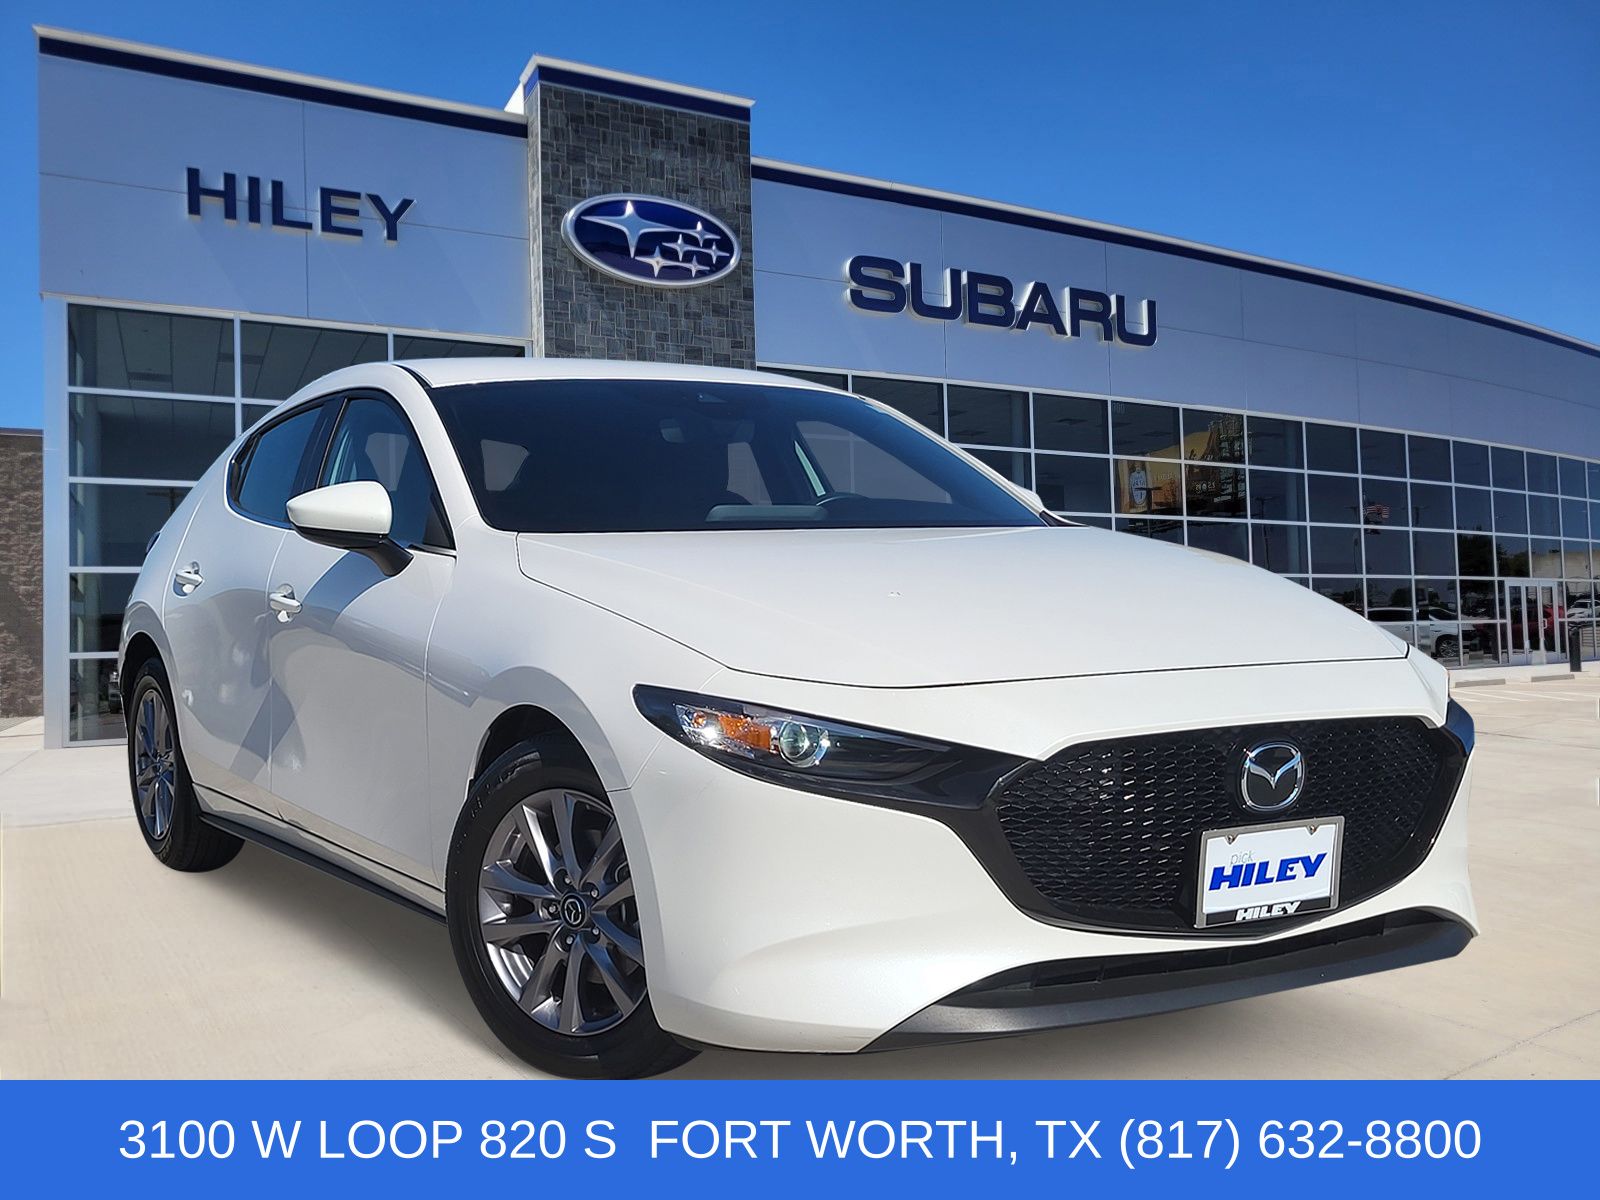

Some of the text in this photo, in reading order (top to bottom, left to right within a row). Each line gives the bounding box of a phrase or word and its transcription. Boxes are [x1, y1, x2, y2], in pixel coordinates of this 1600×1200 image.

[186, 166, 417, 243] HILEY
[846, 254, 1158, 347] SUBARU
[1208, 852, 1328, 891] HILEY
[1229, 850, 1255, 866] pick
[1234, 900, 1301, 922] HILEY
